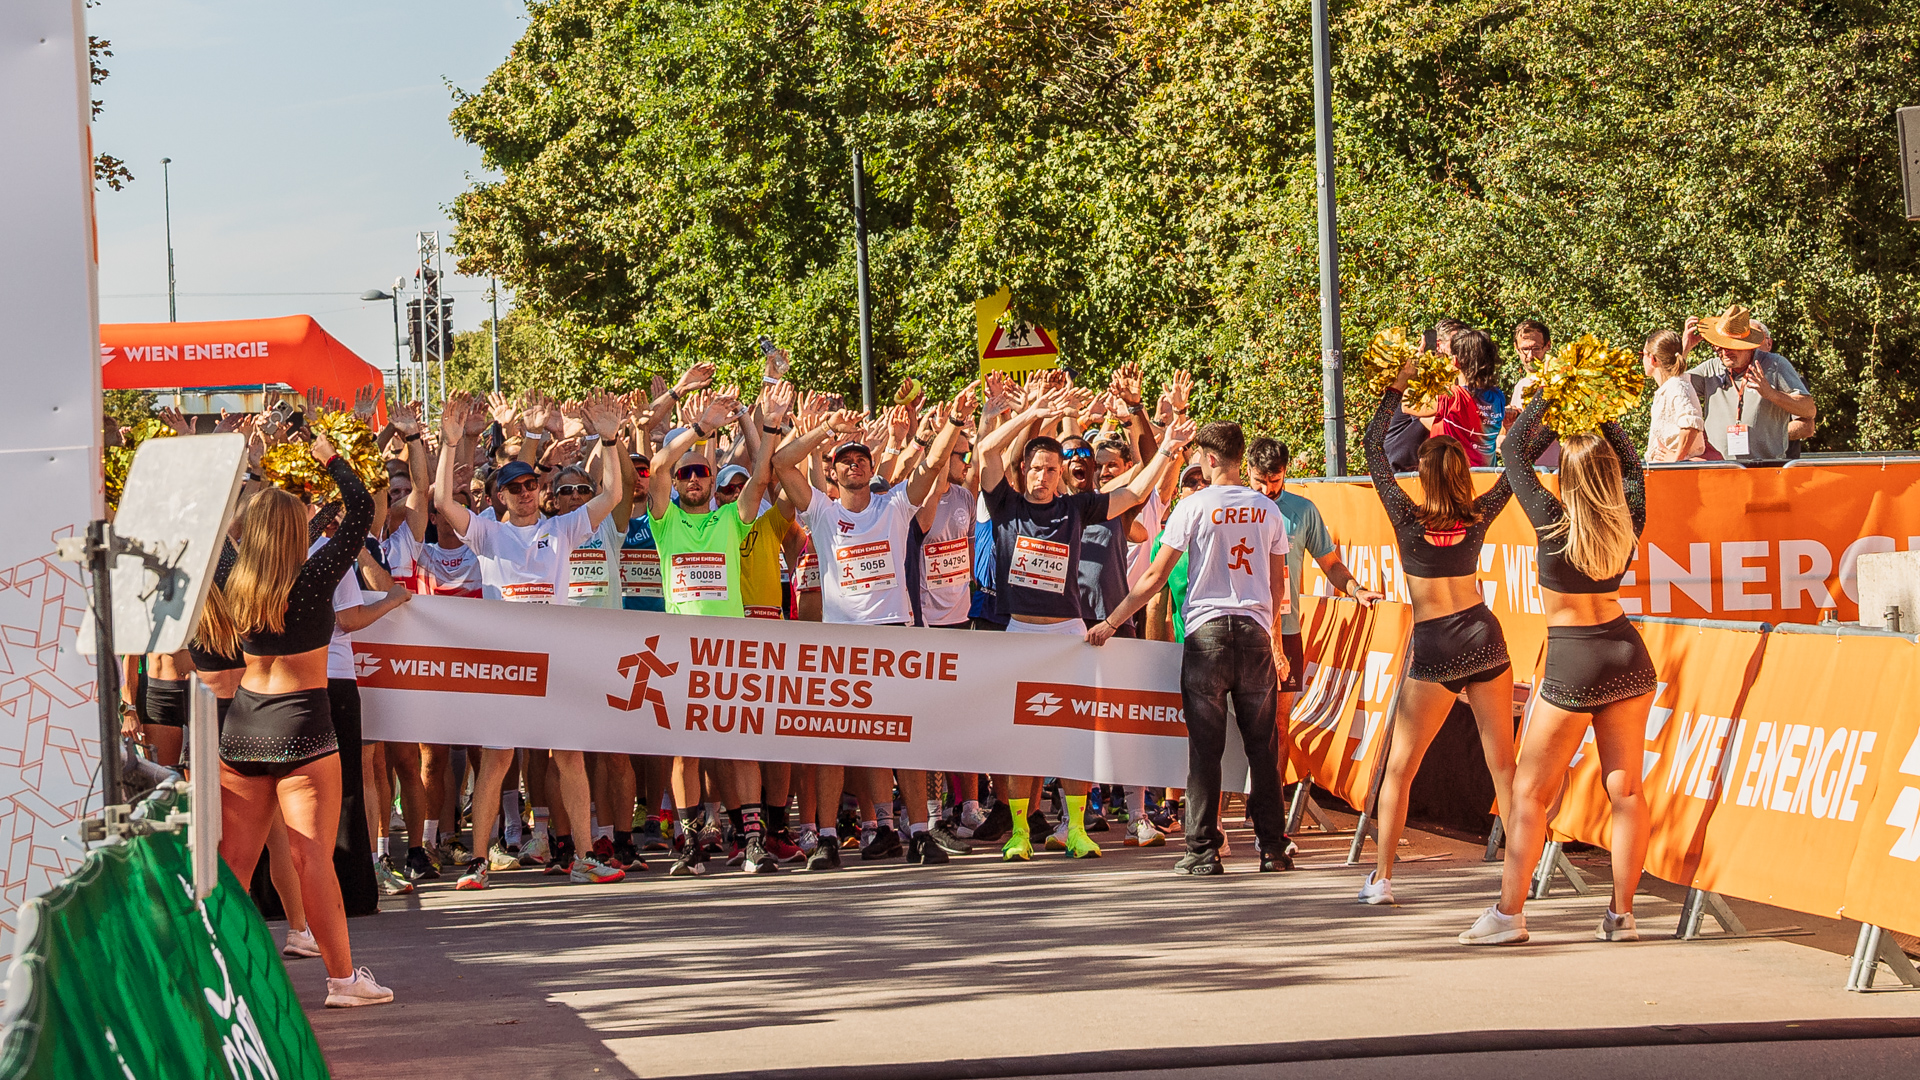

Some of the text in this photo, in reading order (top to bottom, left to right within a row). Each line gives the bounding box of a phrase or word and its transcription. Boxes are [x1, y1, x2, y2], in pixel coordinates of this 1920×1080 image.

[123, 341, 269, 363] WIEN ENERGIE
[1211, 507, 1267, 525] CREW
[537, 539, 549, 549] EY
[850, 544, 888, 555] WIEN ENERGIE
[1030, 542, 1067, 554] WIEN ENERGIE
[860, 559, 886, 571] 505B
[943, 555, 967, 567] 9479C
[1031, 557, 1063, 571] 4714C
[571, 566, 604, 576] 7074C
[631, 567, 661, 576] 5045A
[690, 570, 722, 580] 8008B
[1502, 535, 1920, 615] WIE ENERG
[689, 636, 959, 682] WIEN ENERGIE
[390, 658, 539, 682] WIEN ENERGIE
[687, 670, 873, 709] BUSINESS
[1070, 698, 1186, 723] WIEN ENERG
[684, 703, 908, 737] RUN DONAUINSEL
[1665, 711, 1878, 822] WIEN ENERGIE
